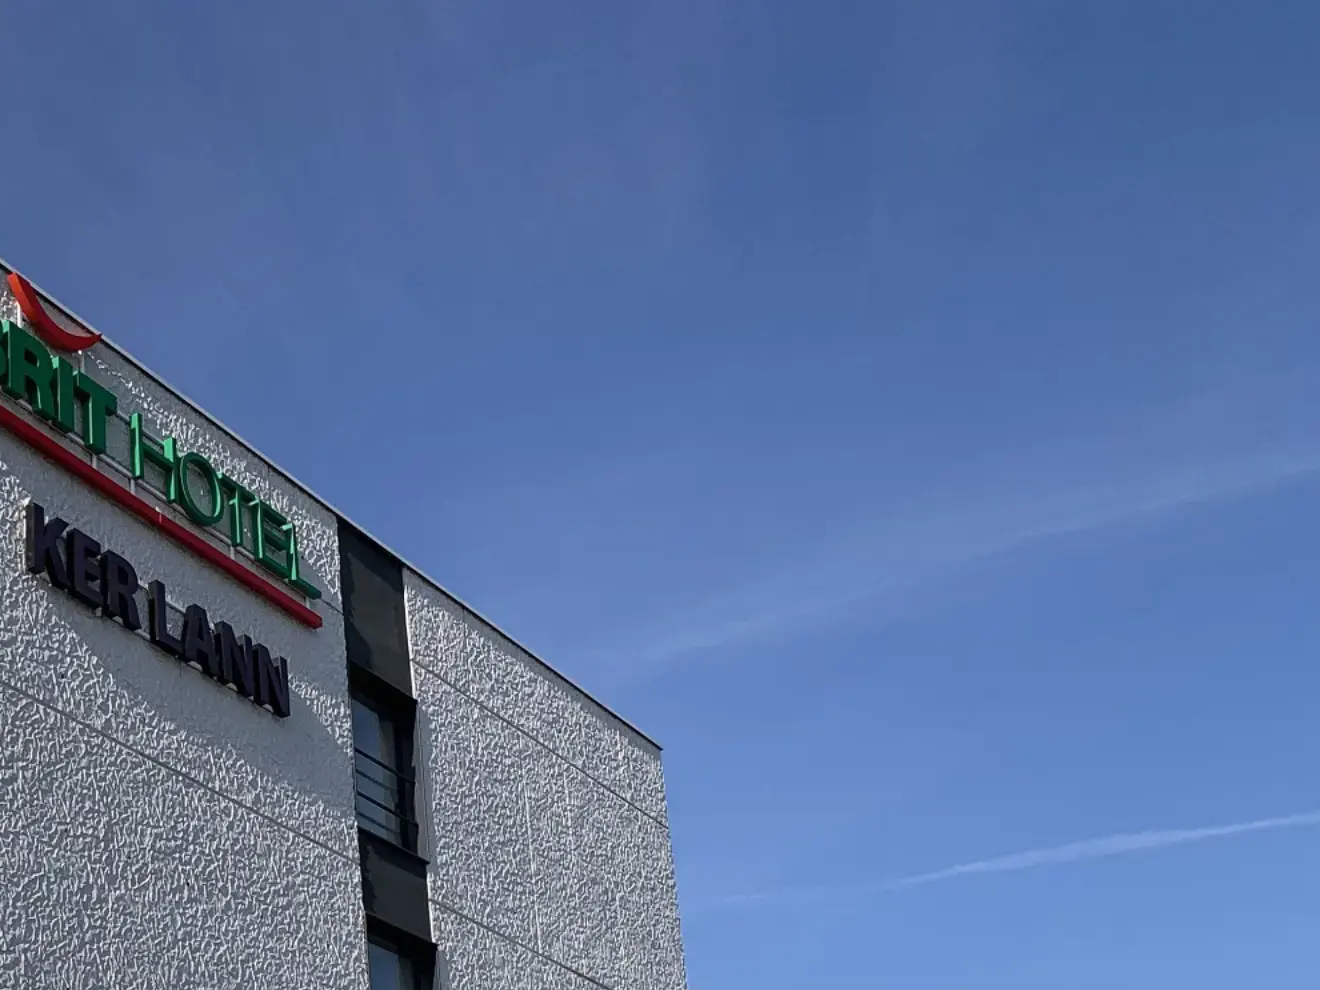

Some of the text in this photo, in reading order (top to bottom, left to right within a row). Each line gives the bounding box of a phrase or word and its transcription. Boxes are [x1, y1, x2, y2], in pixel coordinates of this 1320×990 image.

[128, 412, 322, 599] HOTEL
[25, 500, 291, 718] KER LANN
